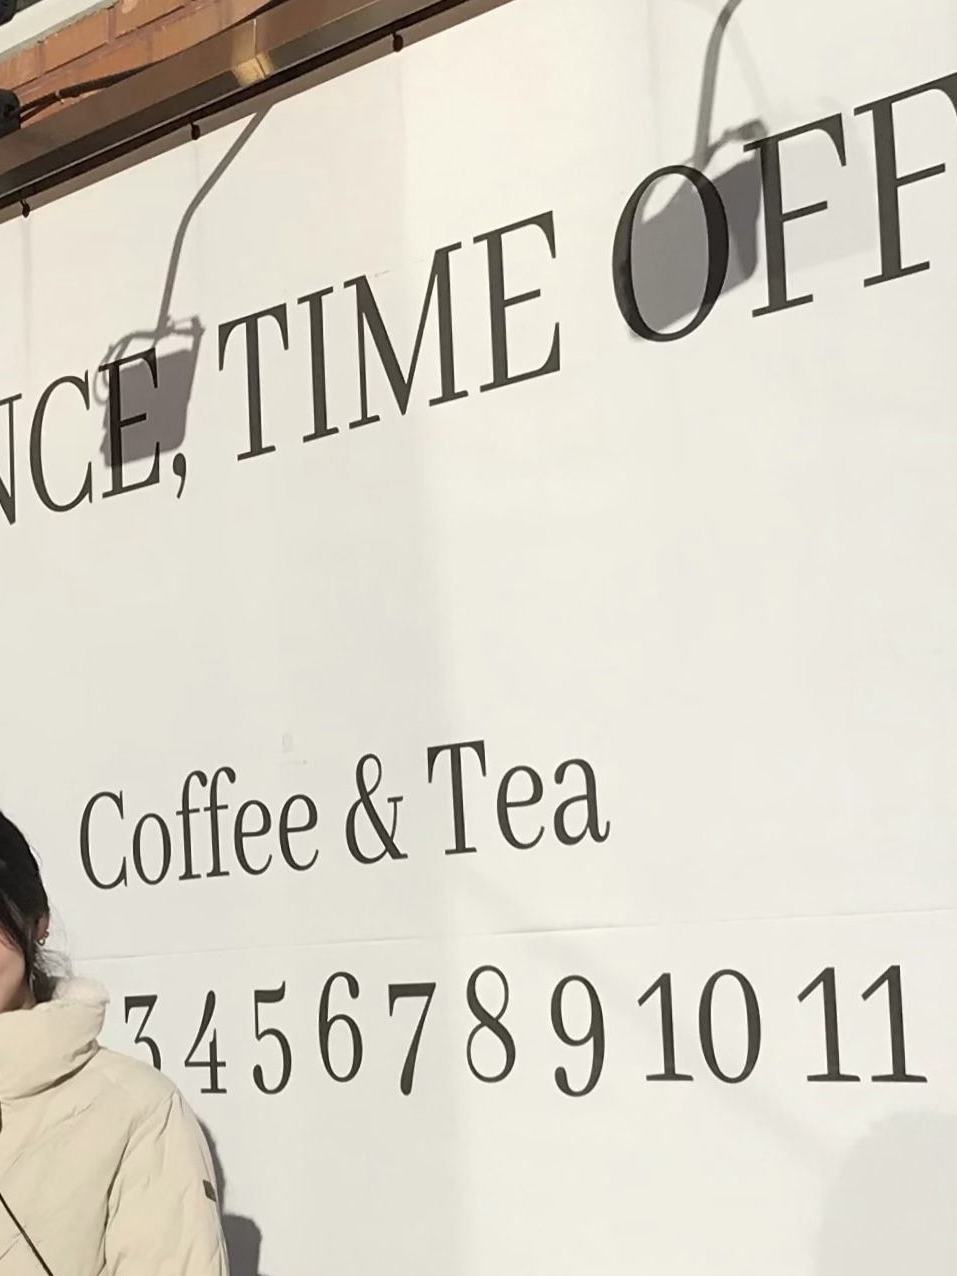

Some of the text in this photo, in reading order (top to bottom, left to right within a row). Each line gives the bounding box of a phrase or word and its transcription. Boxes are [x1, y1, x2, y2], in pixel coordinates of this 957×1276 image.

[217, 209, 561, 462] TIME
[612, 72, 957, 343] OFF
[79, 739, 612, 891] Coffee & Tea
[124, 964, 928, 1098] 3 4 5 6 7 8 9 10 11
